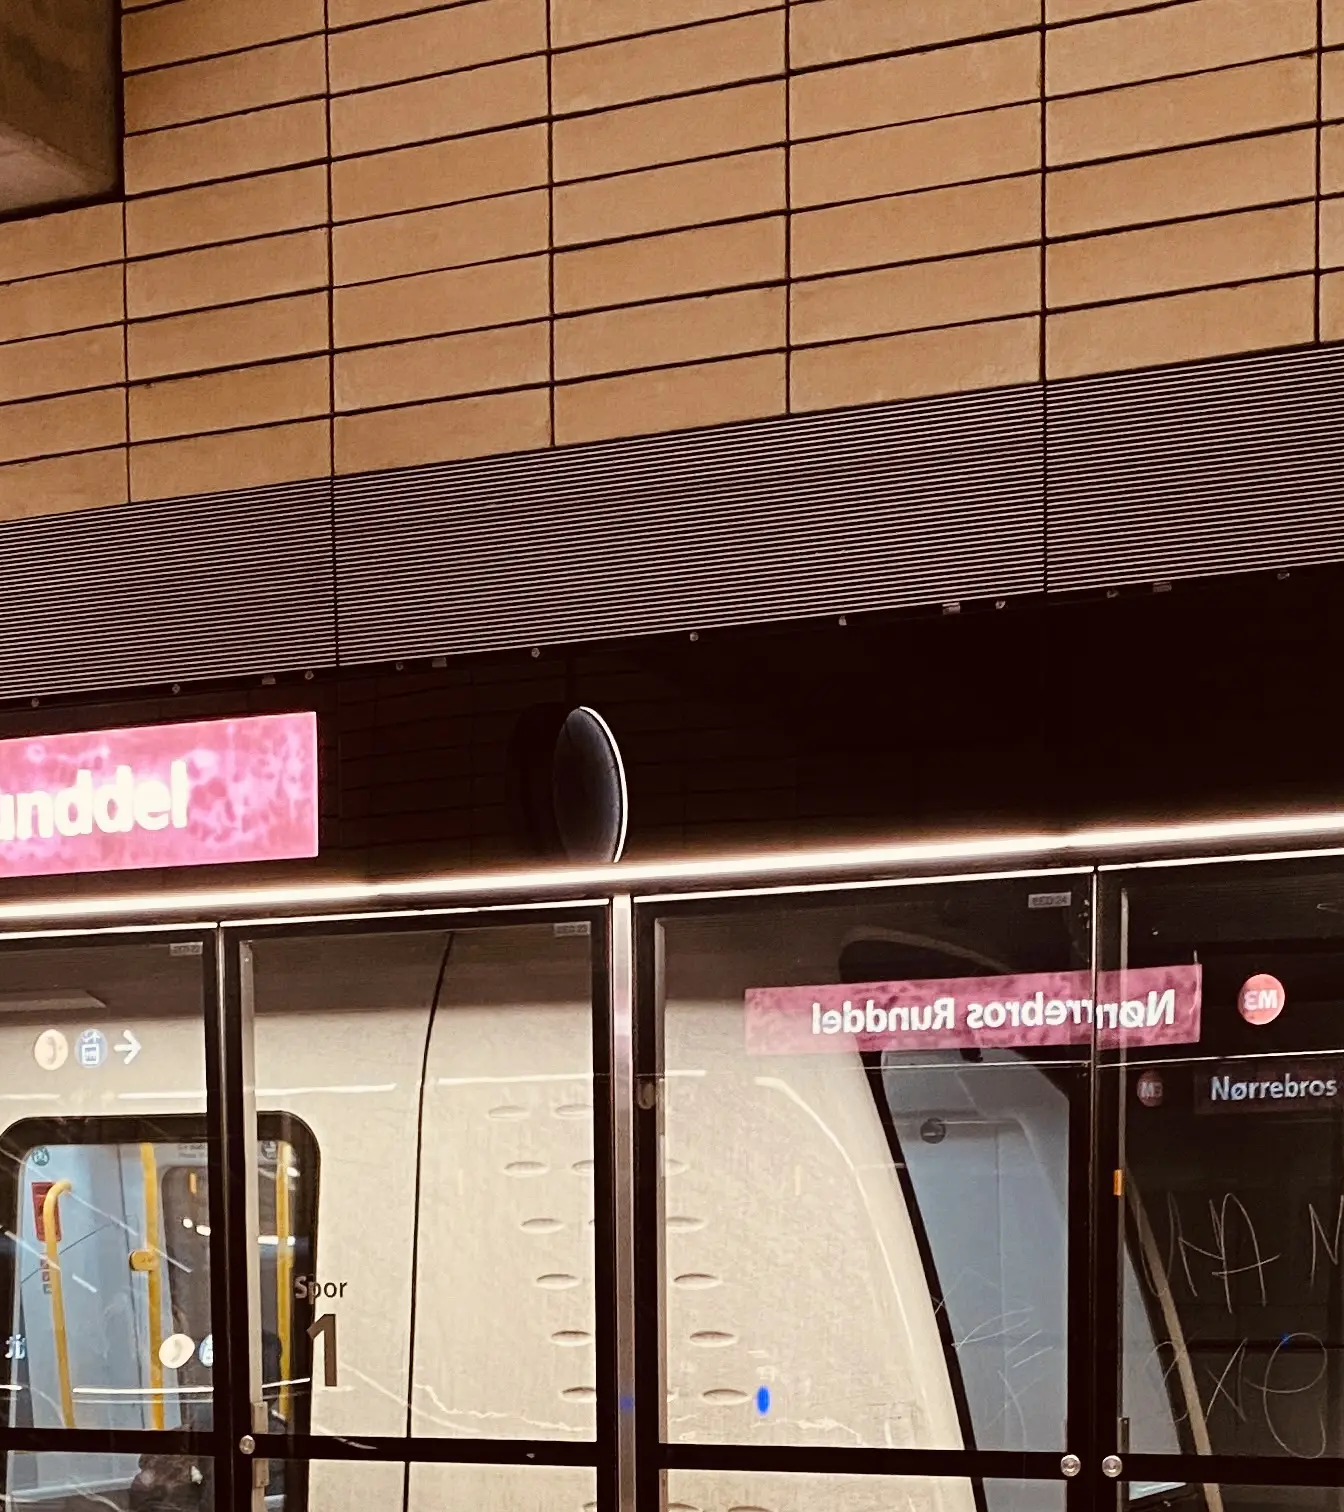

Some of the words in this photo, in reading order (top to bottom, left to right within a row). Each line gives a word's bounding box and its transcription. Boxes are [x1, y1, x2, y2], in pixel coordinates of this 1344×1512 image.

[1211, 1073, 1338, 1101] Nørrebros
[295, 1275, 348, 1305] Spor
[306, 1313, 338, 1387] 1
